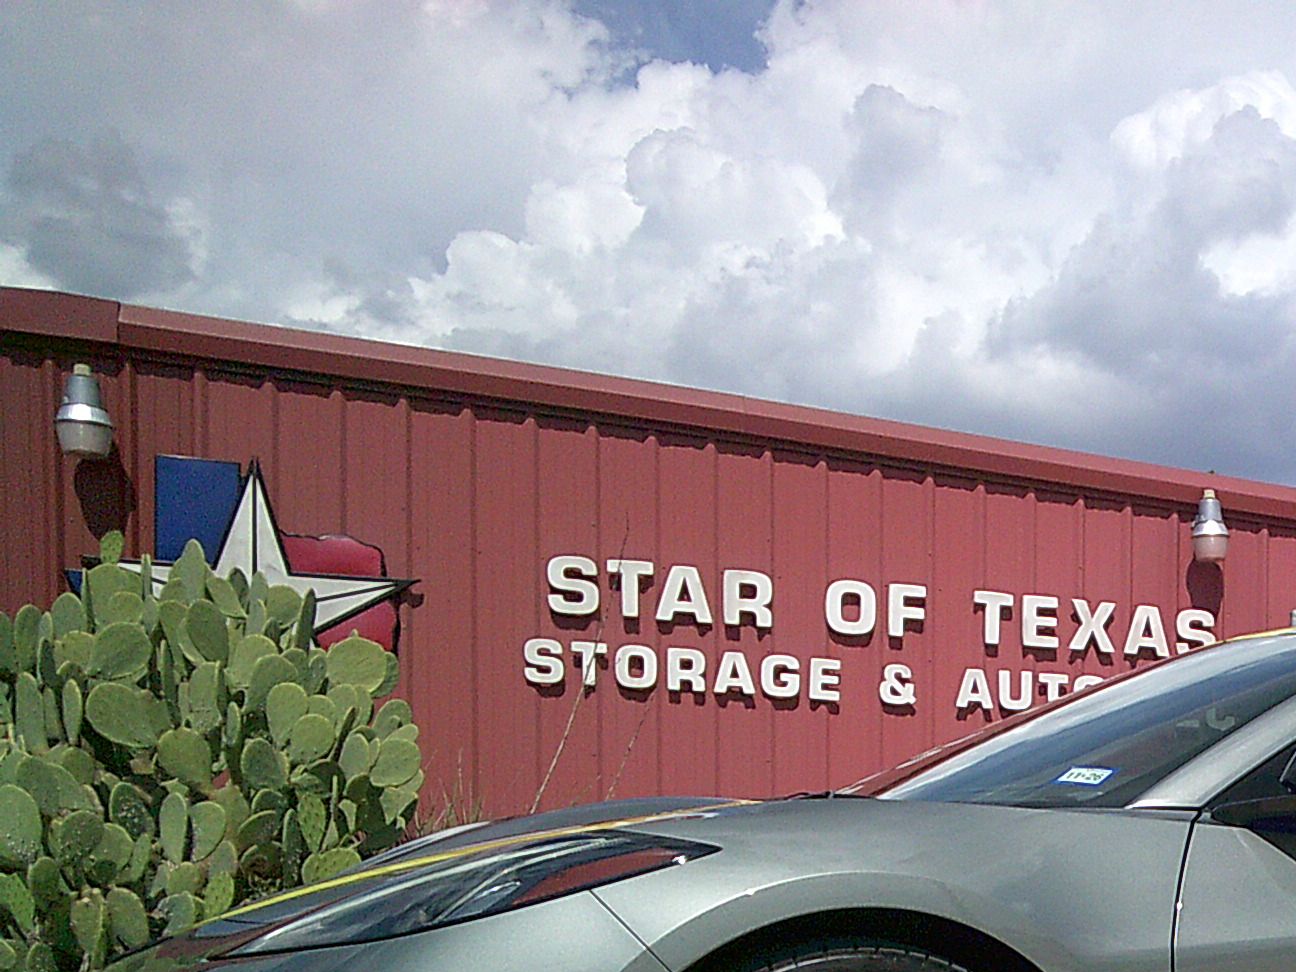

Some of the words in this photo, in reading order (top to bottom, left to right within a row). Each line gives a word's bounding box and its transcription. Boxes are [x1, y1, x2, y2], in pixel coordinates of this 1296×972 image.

[547, 555, 773, 628] STAR
[825, 579, 927, 637] OF
[973, 590, 1217, 659] TEXAS
[524, 638, 842, 702] STORAGE
[879, 663, 917, 705] &
